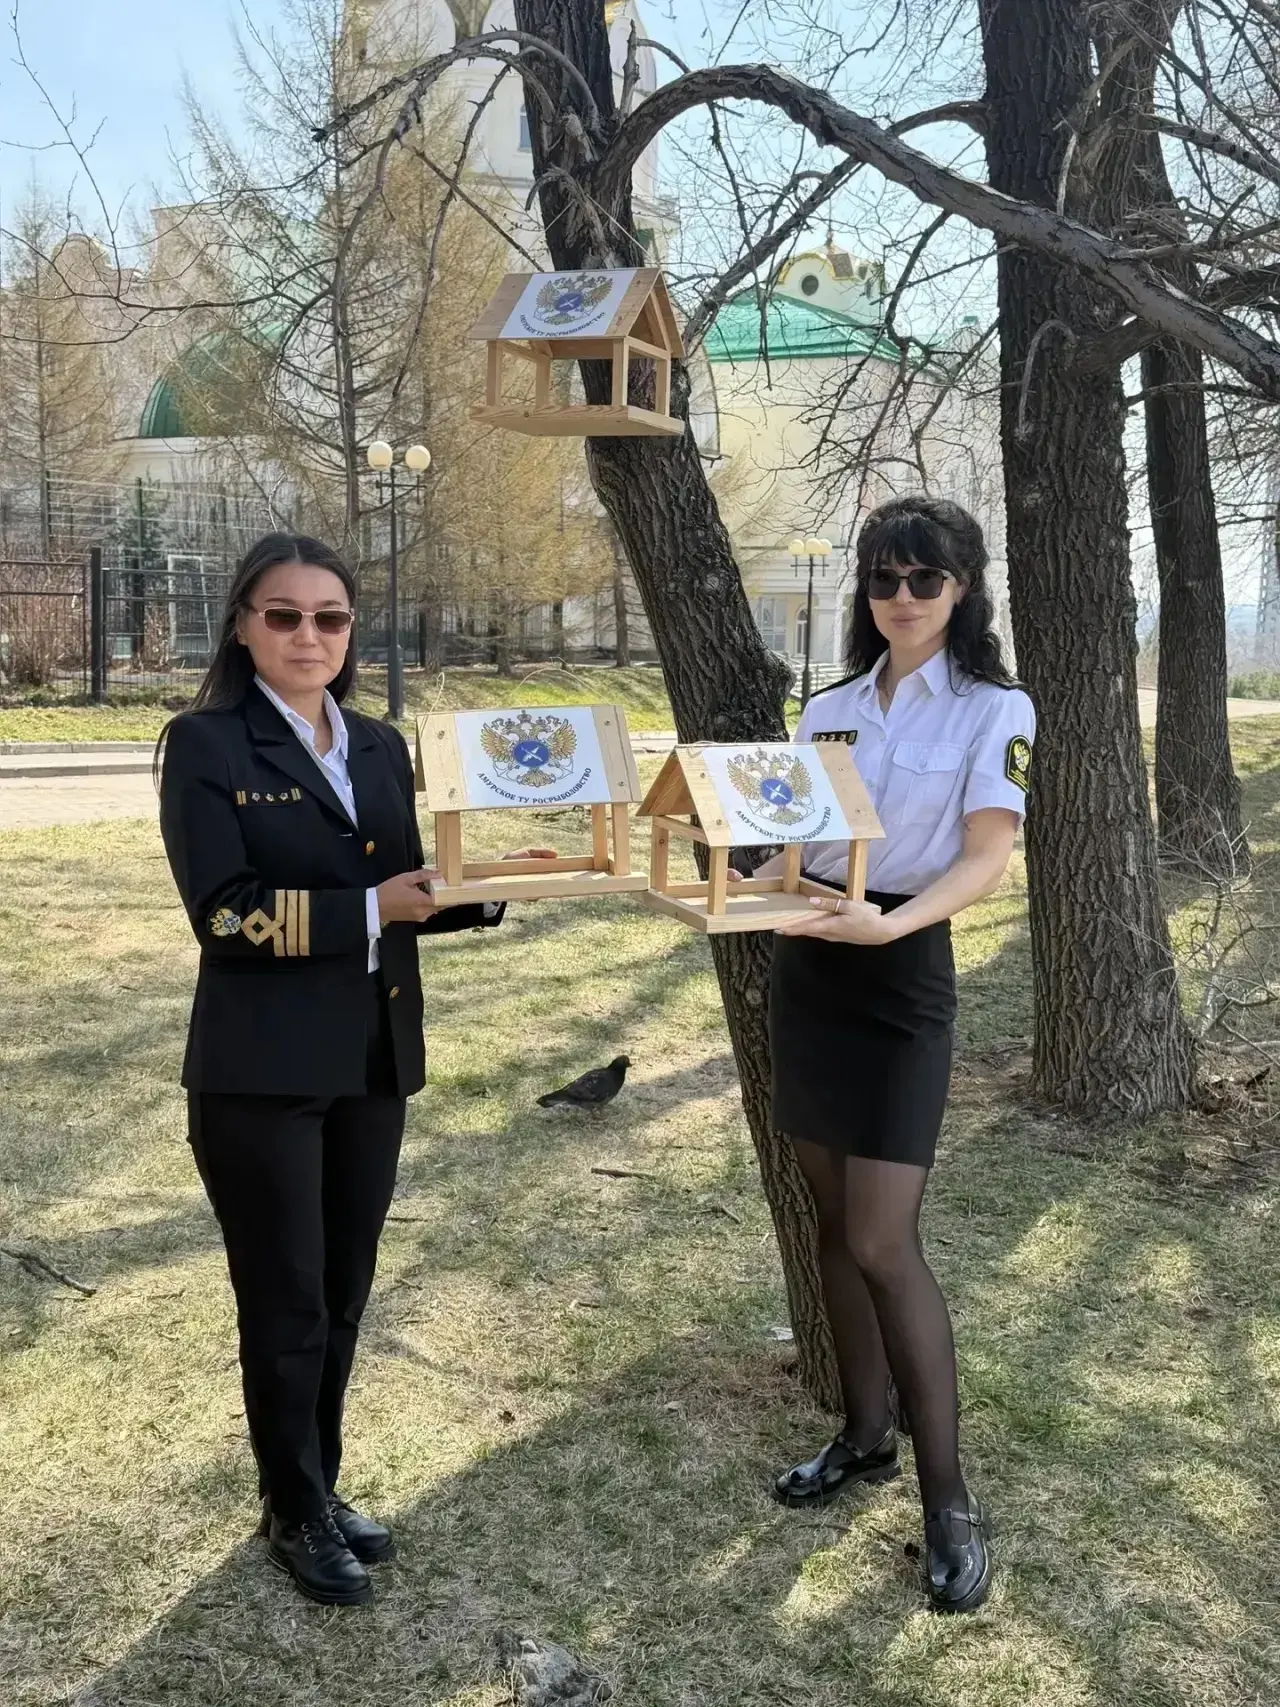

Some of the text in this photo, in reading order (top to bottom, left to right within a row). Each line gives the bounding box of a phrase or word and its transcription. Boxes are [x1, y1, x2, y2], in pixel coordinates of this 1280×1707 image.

[477, 772, 516, 801] АМУРСКОЕ
[532, 767, 592, 804] РОСРЫБОЛОВСТВО
[736, 810, 774, 839] АМУРСКОЕ
[788, 806, 831, 842] РОСРЫБОЛОВСТВО
